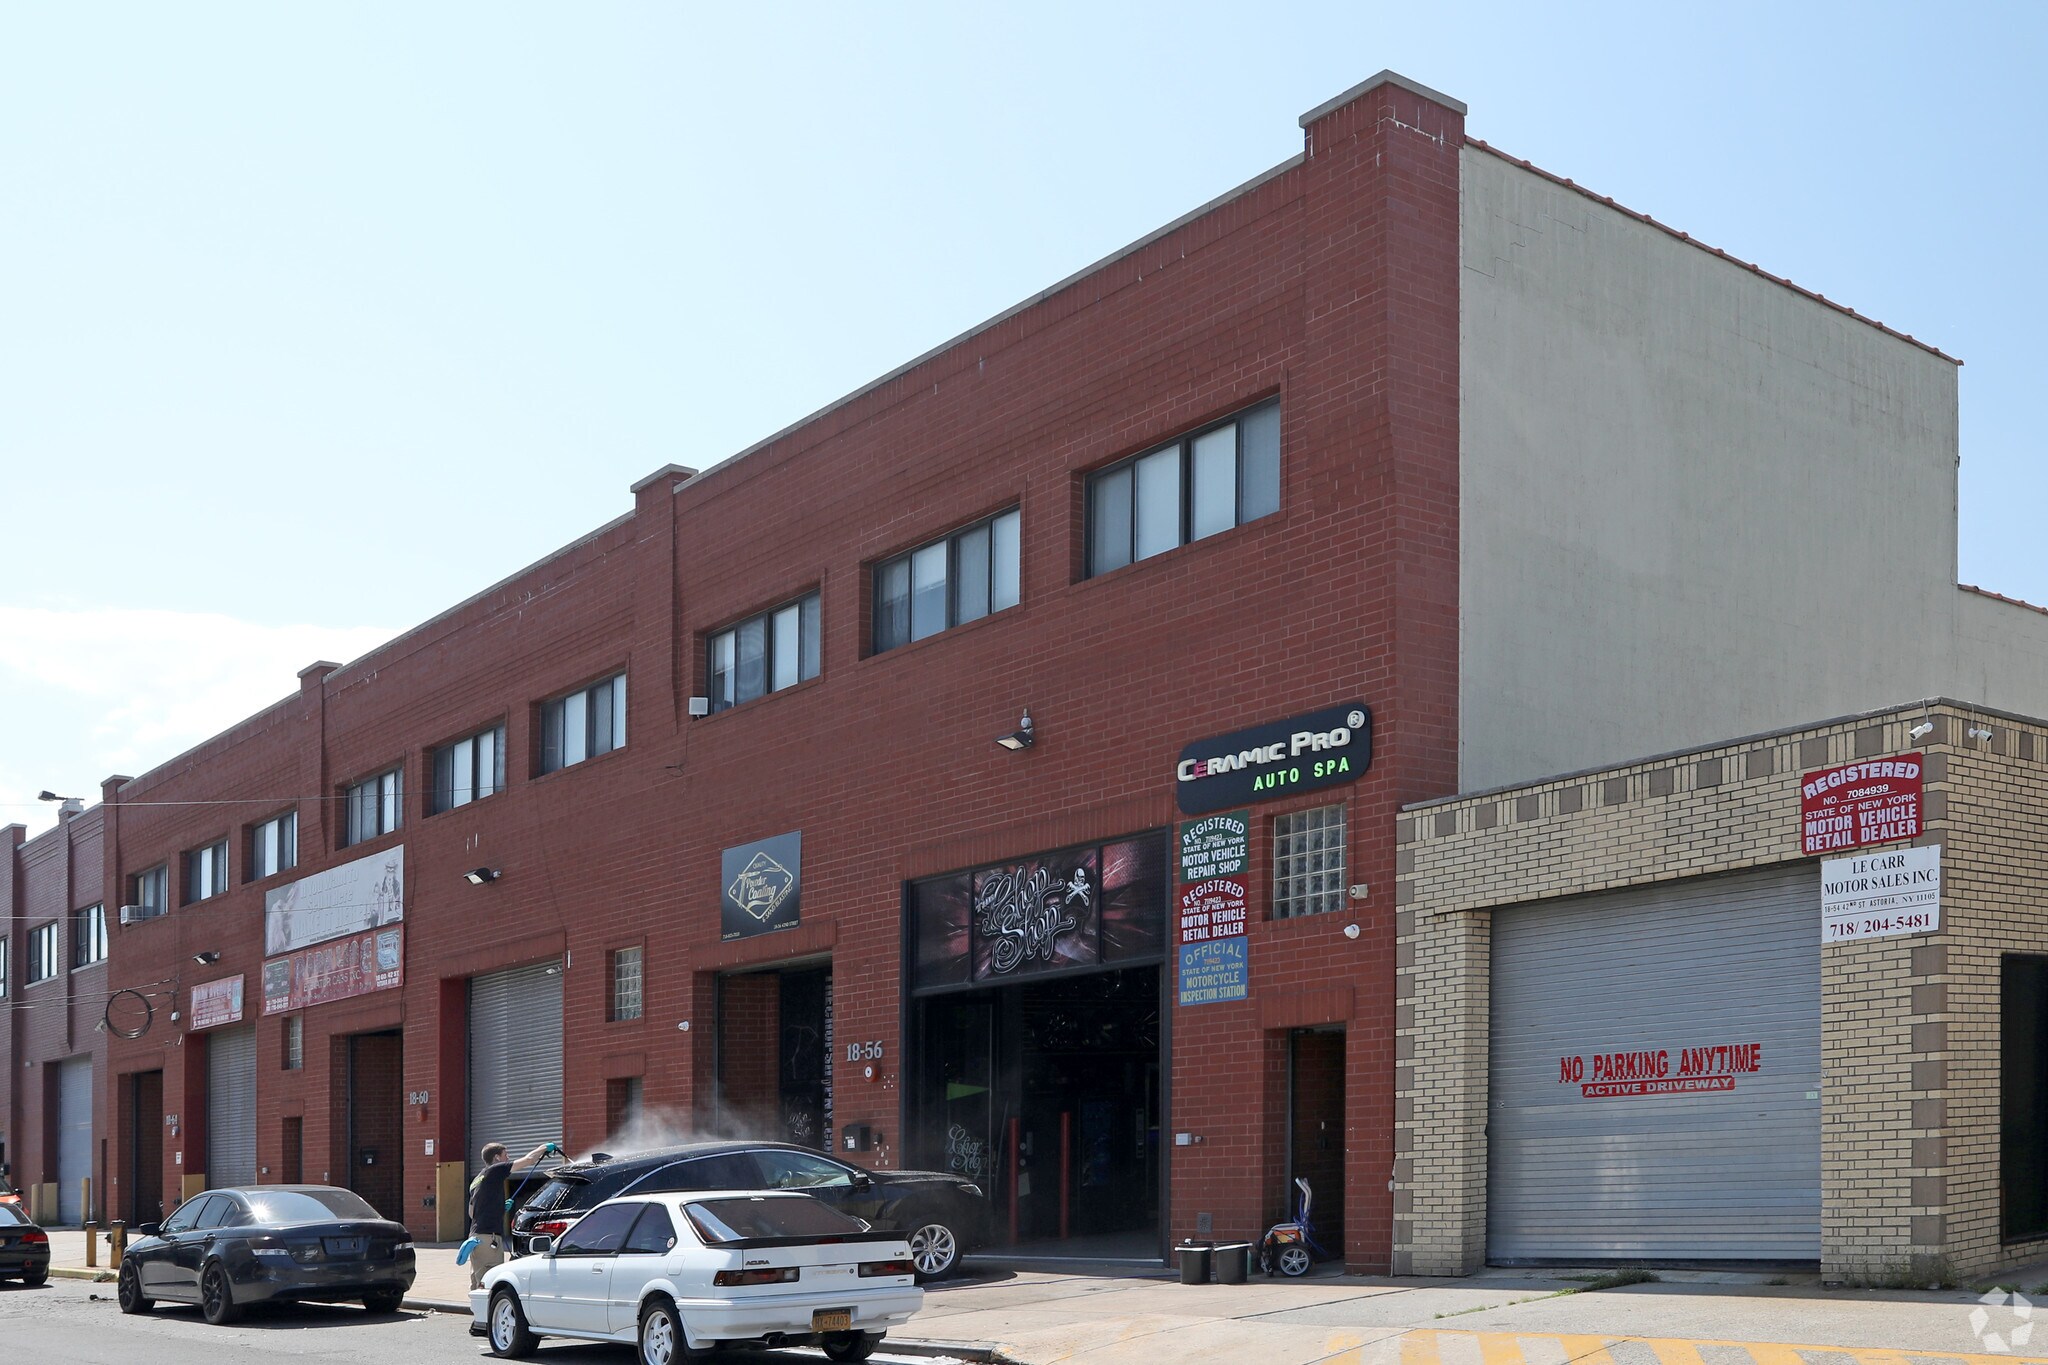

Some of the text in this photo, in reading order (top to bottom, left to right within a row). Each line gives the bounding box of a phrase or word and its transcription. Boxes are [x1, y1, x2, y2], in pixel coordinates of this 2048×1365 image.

[1253, 757, 1350, 791] AUTO SPA
[1803, 761, 1919, 799] REGISTERED
[1823, 783, 1889, 806] NO. 7084939
[1805, 793, 1916, 820] STATE OF NEW YORK
[1805, 803, 1917, 836] MOTOR VEHICLE
[1183, 817, 1244, 845] REGISTERED
[1806, 819, 1917, 852] RETAIL DEALER
[1183, 845, 1201, 853] STATE
[1212, 840, 1225, 848] NEW
[1227, 836, 1244, 844] YORK
[1182, 845, 1245, 867] MOTOR VEHICLE
[1852, 854, 1905, 874] LE CARR
[1188, 859, 1241, 879] REPAIR SHOP
[1824, 868, 1938, 896] MOTOR SALES INC.
[748, 885, 776, 902] Coating
[1182, 880, 1244, 907] REGISTERED
[1858, 901, 1866, 909] ST
[1902, 895, 1914, 904] NY
[1916, 892, 1936, 901] 11105
[1181, 907, 1246, 928] MOTOR VEHICLE
[1182, 907, 1200, 915] STATE
[1227, 899, 1244, 907] YORK
[1182, 921, 1243, 941] RETAIL DEALER
[1830, 913, 1930, 937] 718/ 204-5481
[991, 905, 1077, 974] Shop
[1185, 943, 1242, 965] OFFICIAL
[1182, 967, 1199, 976] STATE
[1211, 964, 1225, 972] NEW
[1227, 962, 1244, 970] YORK
[1186, 971, 1239, 988] MOTORCYCLE
[1181, 984, 1245, 1003] INSPECTION STATION
[846, 1040, 883, 1062] 18-56
[1559, 1043, 1761, 1084] NO PARKING ANYTIME
[409, 1090, 428, 1105] 18-60
[1584, 1077, 1732, 1096] ACTIVE DRIVEWAY
